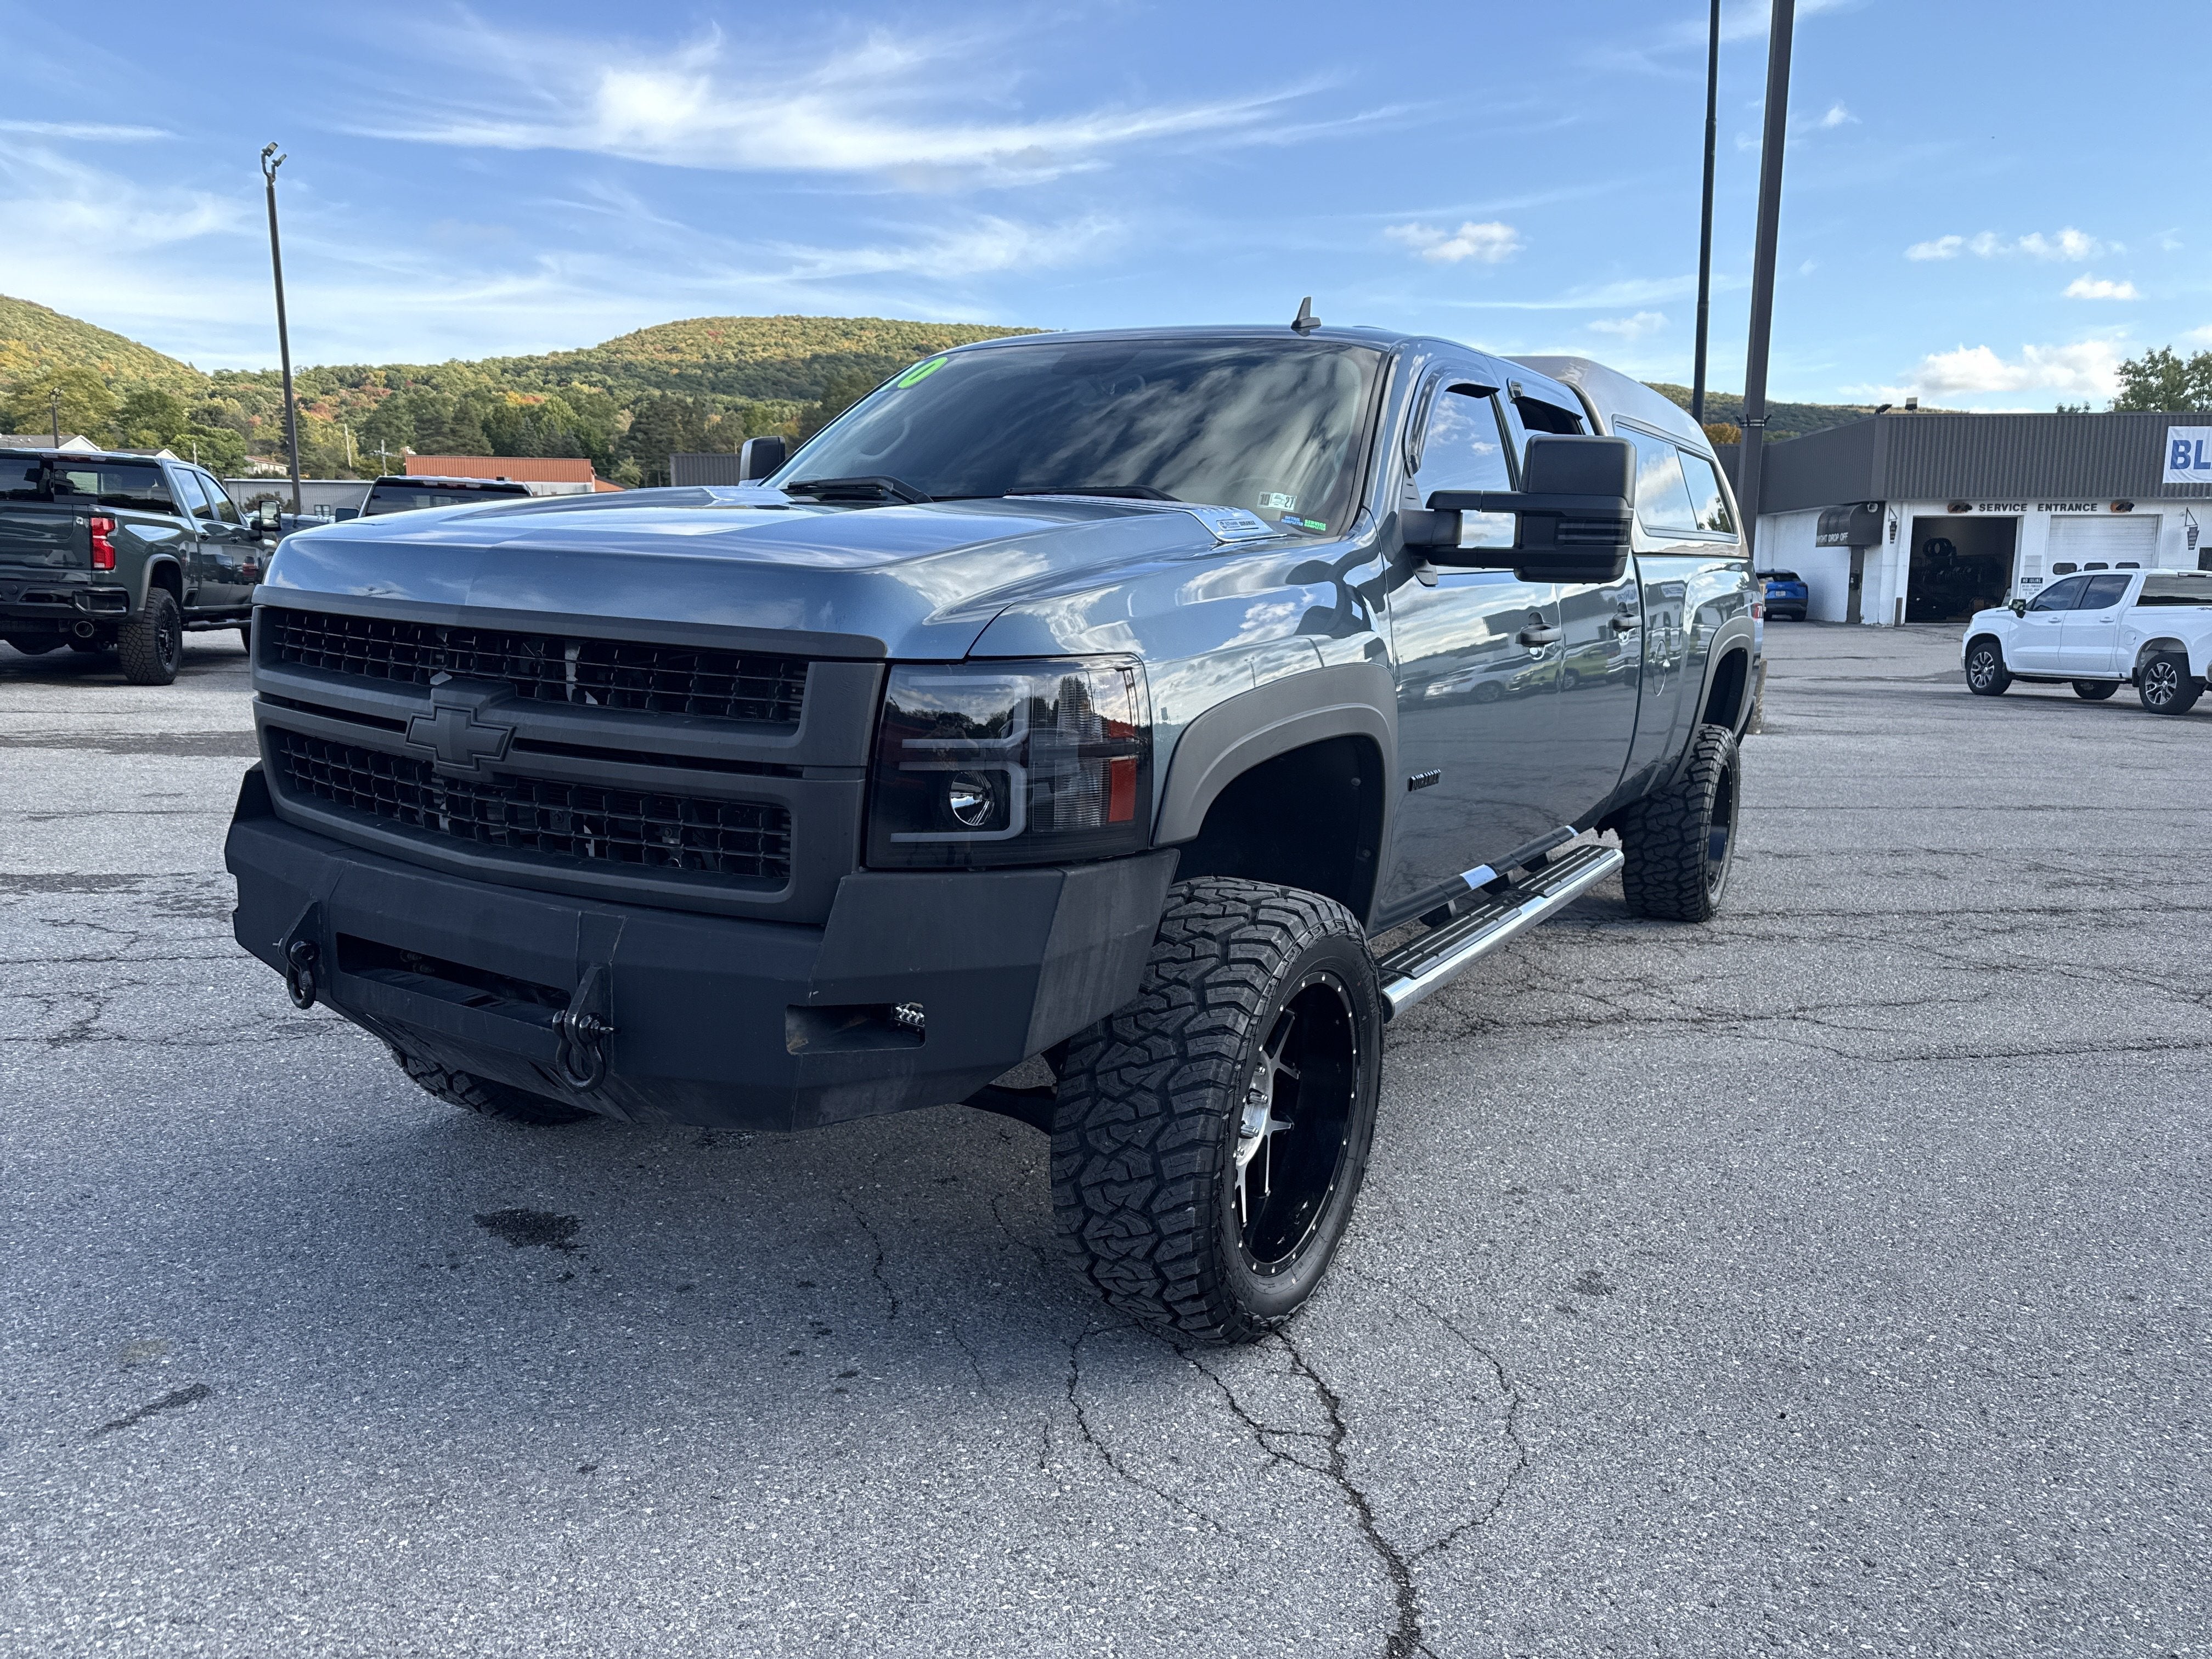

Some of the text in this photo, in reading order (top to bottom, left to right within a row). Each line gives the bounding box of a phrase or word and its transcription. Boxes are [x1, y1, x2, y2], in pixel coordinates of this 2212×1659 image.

[2170, 439, 2212, 470] BL
[1284, 496, 1295, 509] 27
[1979, 503, 2097, 512] SERVICE ENTRANCE
[1305, 519, 1326, 528] SERVICE
[1840, 532, 1848, 541] OFF
